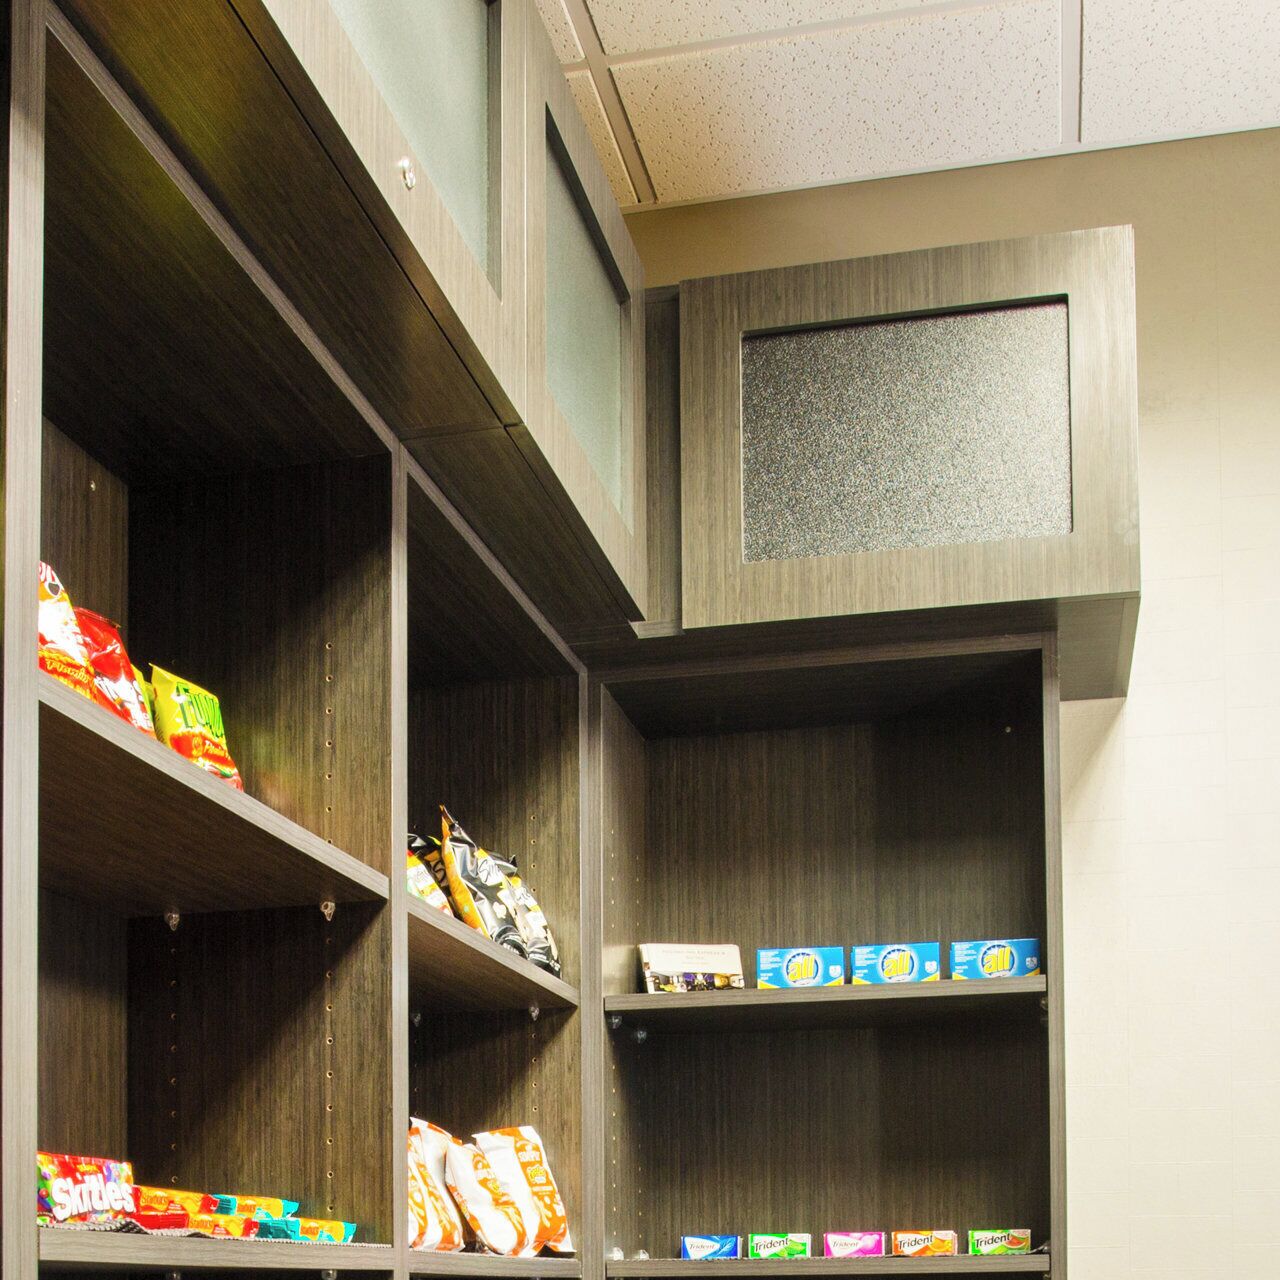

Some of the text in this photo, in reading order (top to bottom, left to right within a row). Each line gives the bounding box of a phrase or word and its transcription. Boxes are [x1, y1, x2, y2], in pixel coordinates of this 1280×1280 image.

[787, 953, 816, 981] all
[883, 950, 911, 978] all
[983, 945, 1011, 974] all
[51, 1172, 136, 1221] Skittles
[753, 1237, 790, 1253] Trident
[897, 1234, 934, 1251] Trident
[974, 1233, 1011, 1248] Trident
